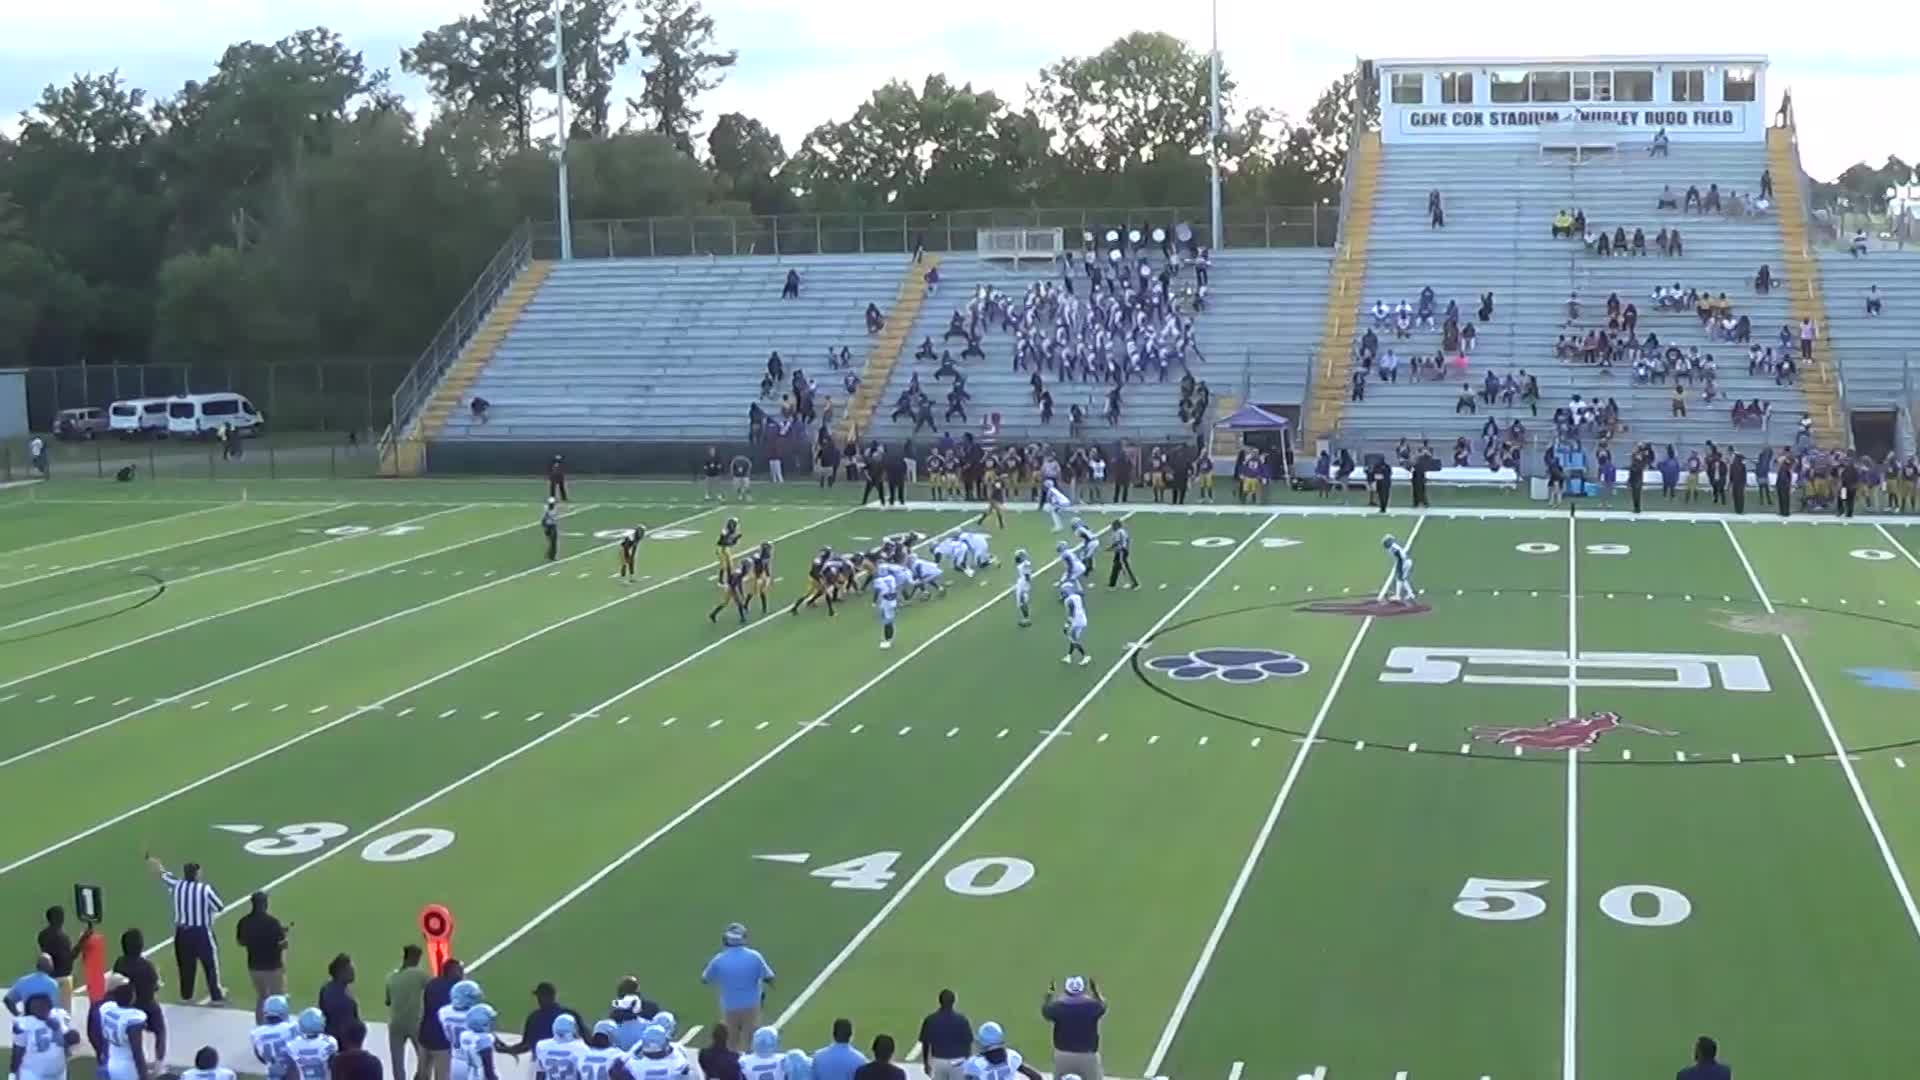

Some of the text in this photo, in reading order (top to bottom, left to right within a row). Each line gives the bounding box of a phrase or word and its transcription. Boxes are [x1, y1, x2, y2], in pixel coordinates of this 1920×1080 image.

[1410, 112, 1447, 126] GENE
[1452, 112, 1484, 126] COX
[1489, 111, 1560, 126] STADIUM
[1694, 110, 1733, 125] FIELD
[82, 887, 95, 915] 1
